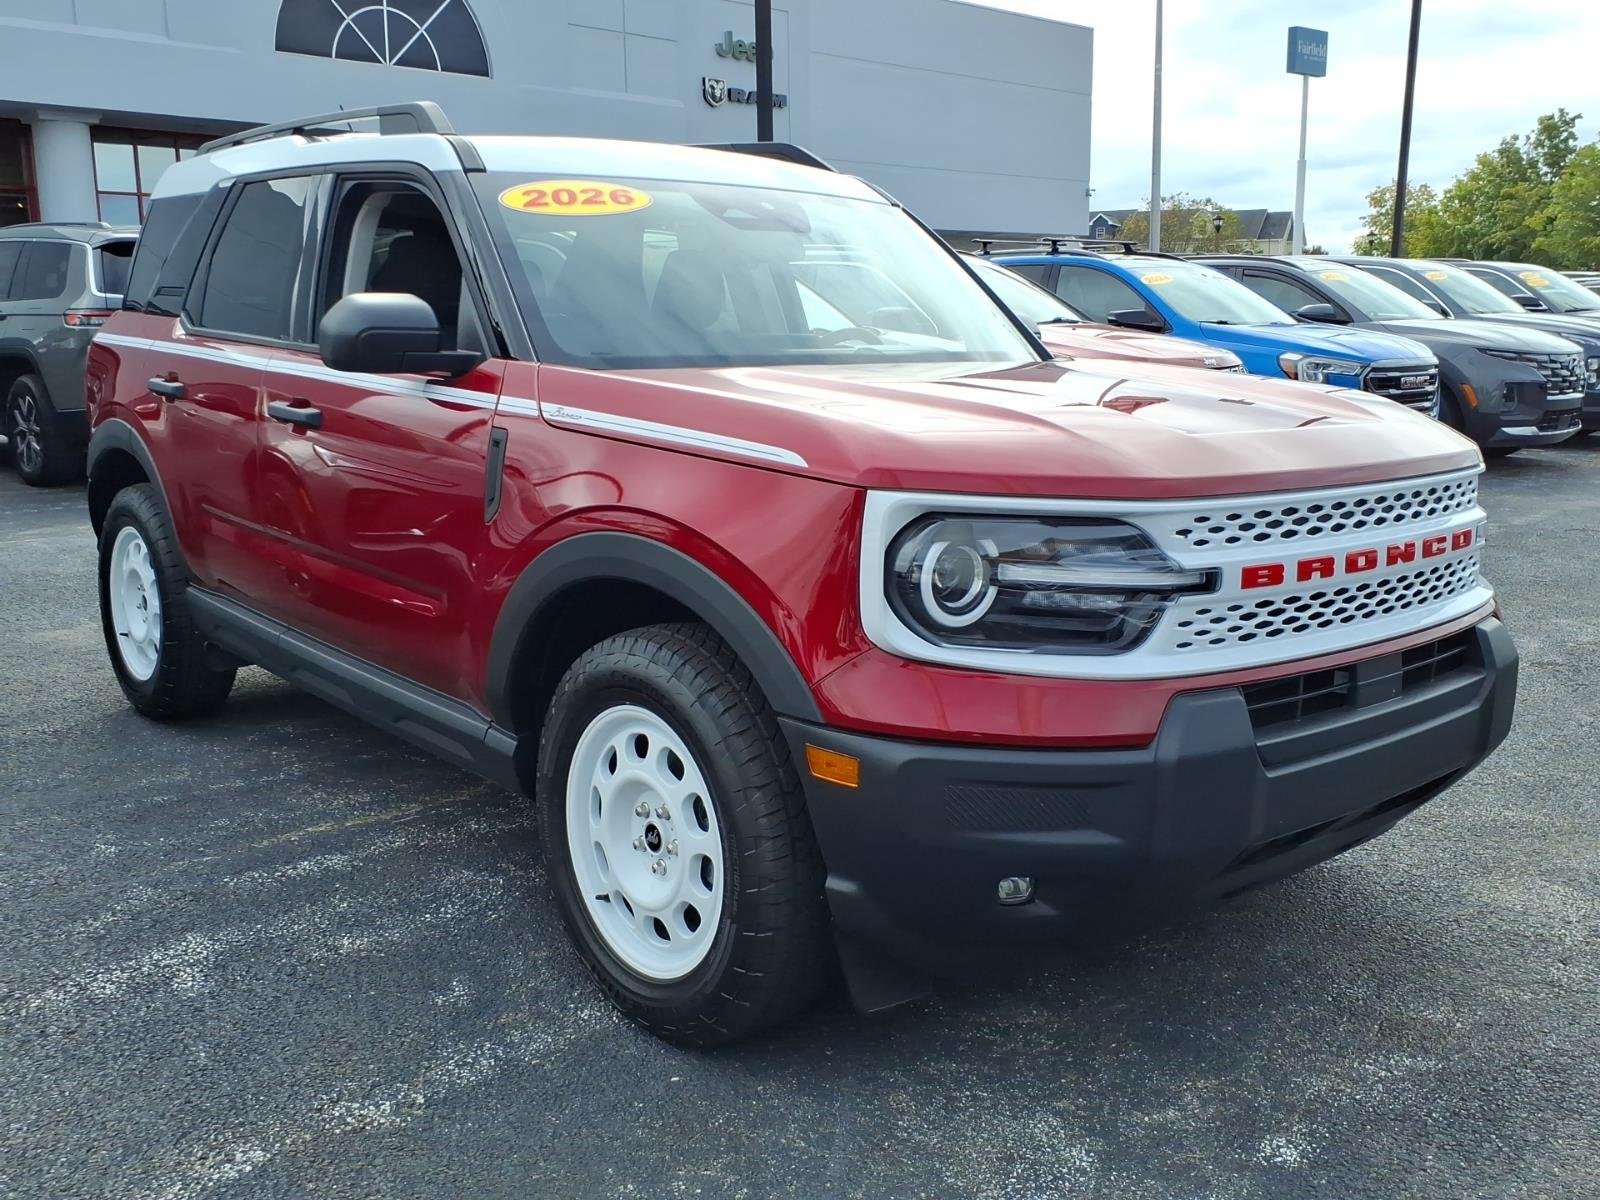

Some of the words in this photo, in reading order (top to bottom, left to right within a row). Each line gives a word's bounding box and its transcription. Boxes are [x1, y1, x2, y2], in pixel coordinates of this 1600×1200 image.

[714, 30, 773, 63] Jee
[521, 188, 635, 208] 2026
[1400, 376, 1430, 389] GMC
[1241, 528, 1473, 590] BRONCO
